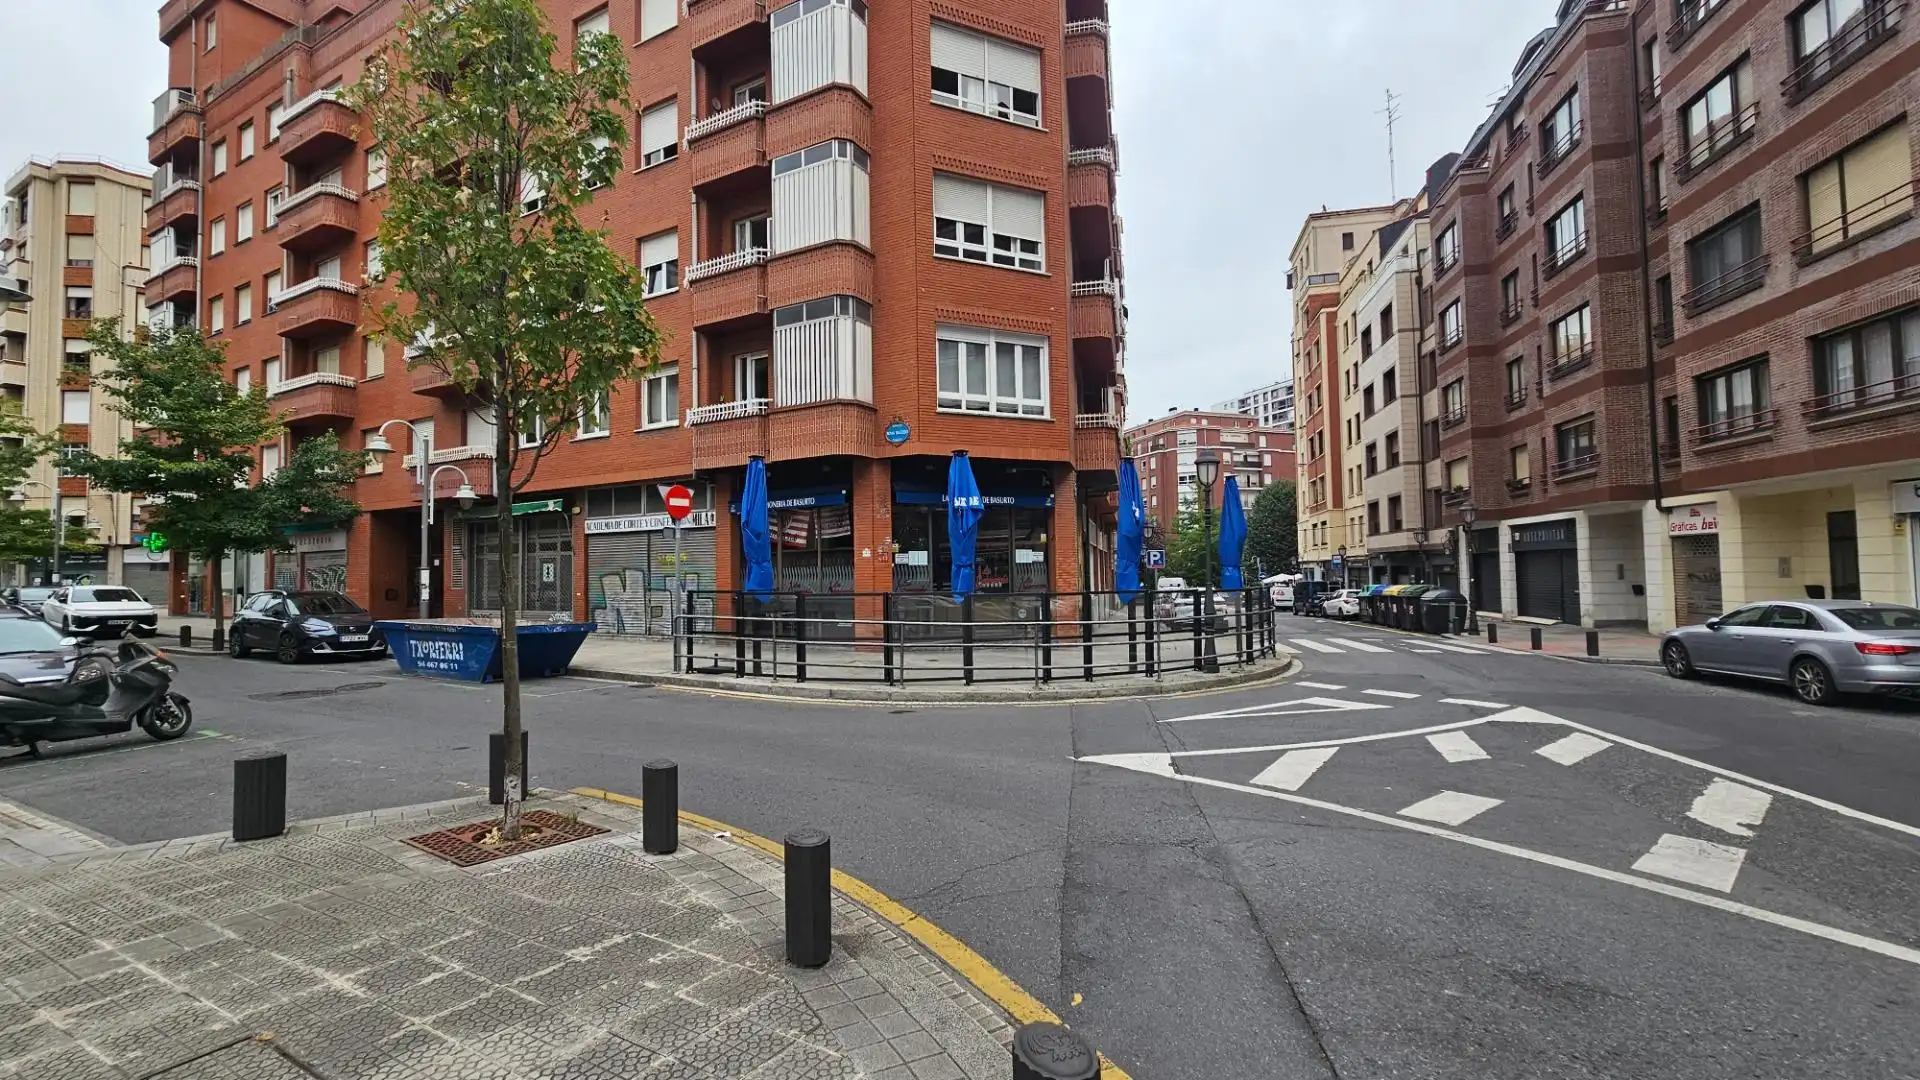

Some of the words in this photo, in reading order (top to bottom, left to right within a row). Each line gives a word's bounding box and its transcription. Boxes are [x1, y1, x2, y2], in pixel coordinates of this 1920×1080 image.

[793, 497, 815, 506] BASURTO
[990, 496, 1015, 504] BASURTO
[586, 520, 613, 531] ACADEMIA
[614, 520, 623, 530] DE
[623, 518, 643, 529] CORTE
[1701, 516, 1718, 530] bei
[1150, 551, 1160, 565] P
[409, 639, 464, 660] TXORIERRI
